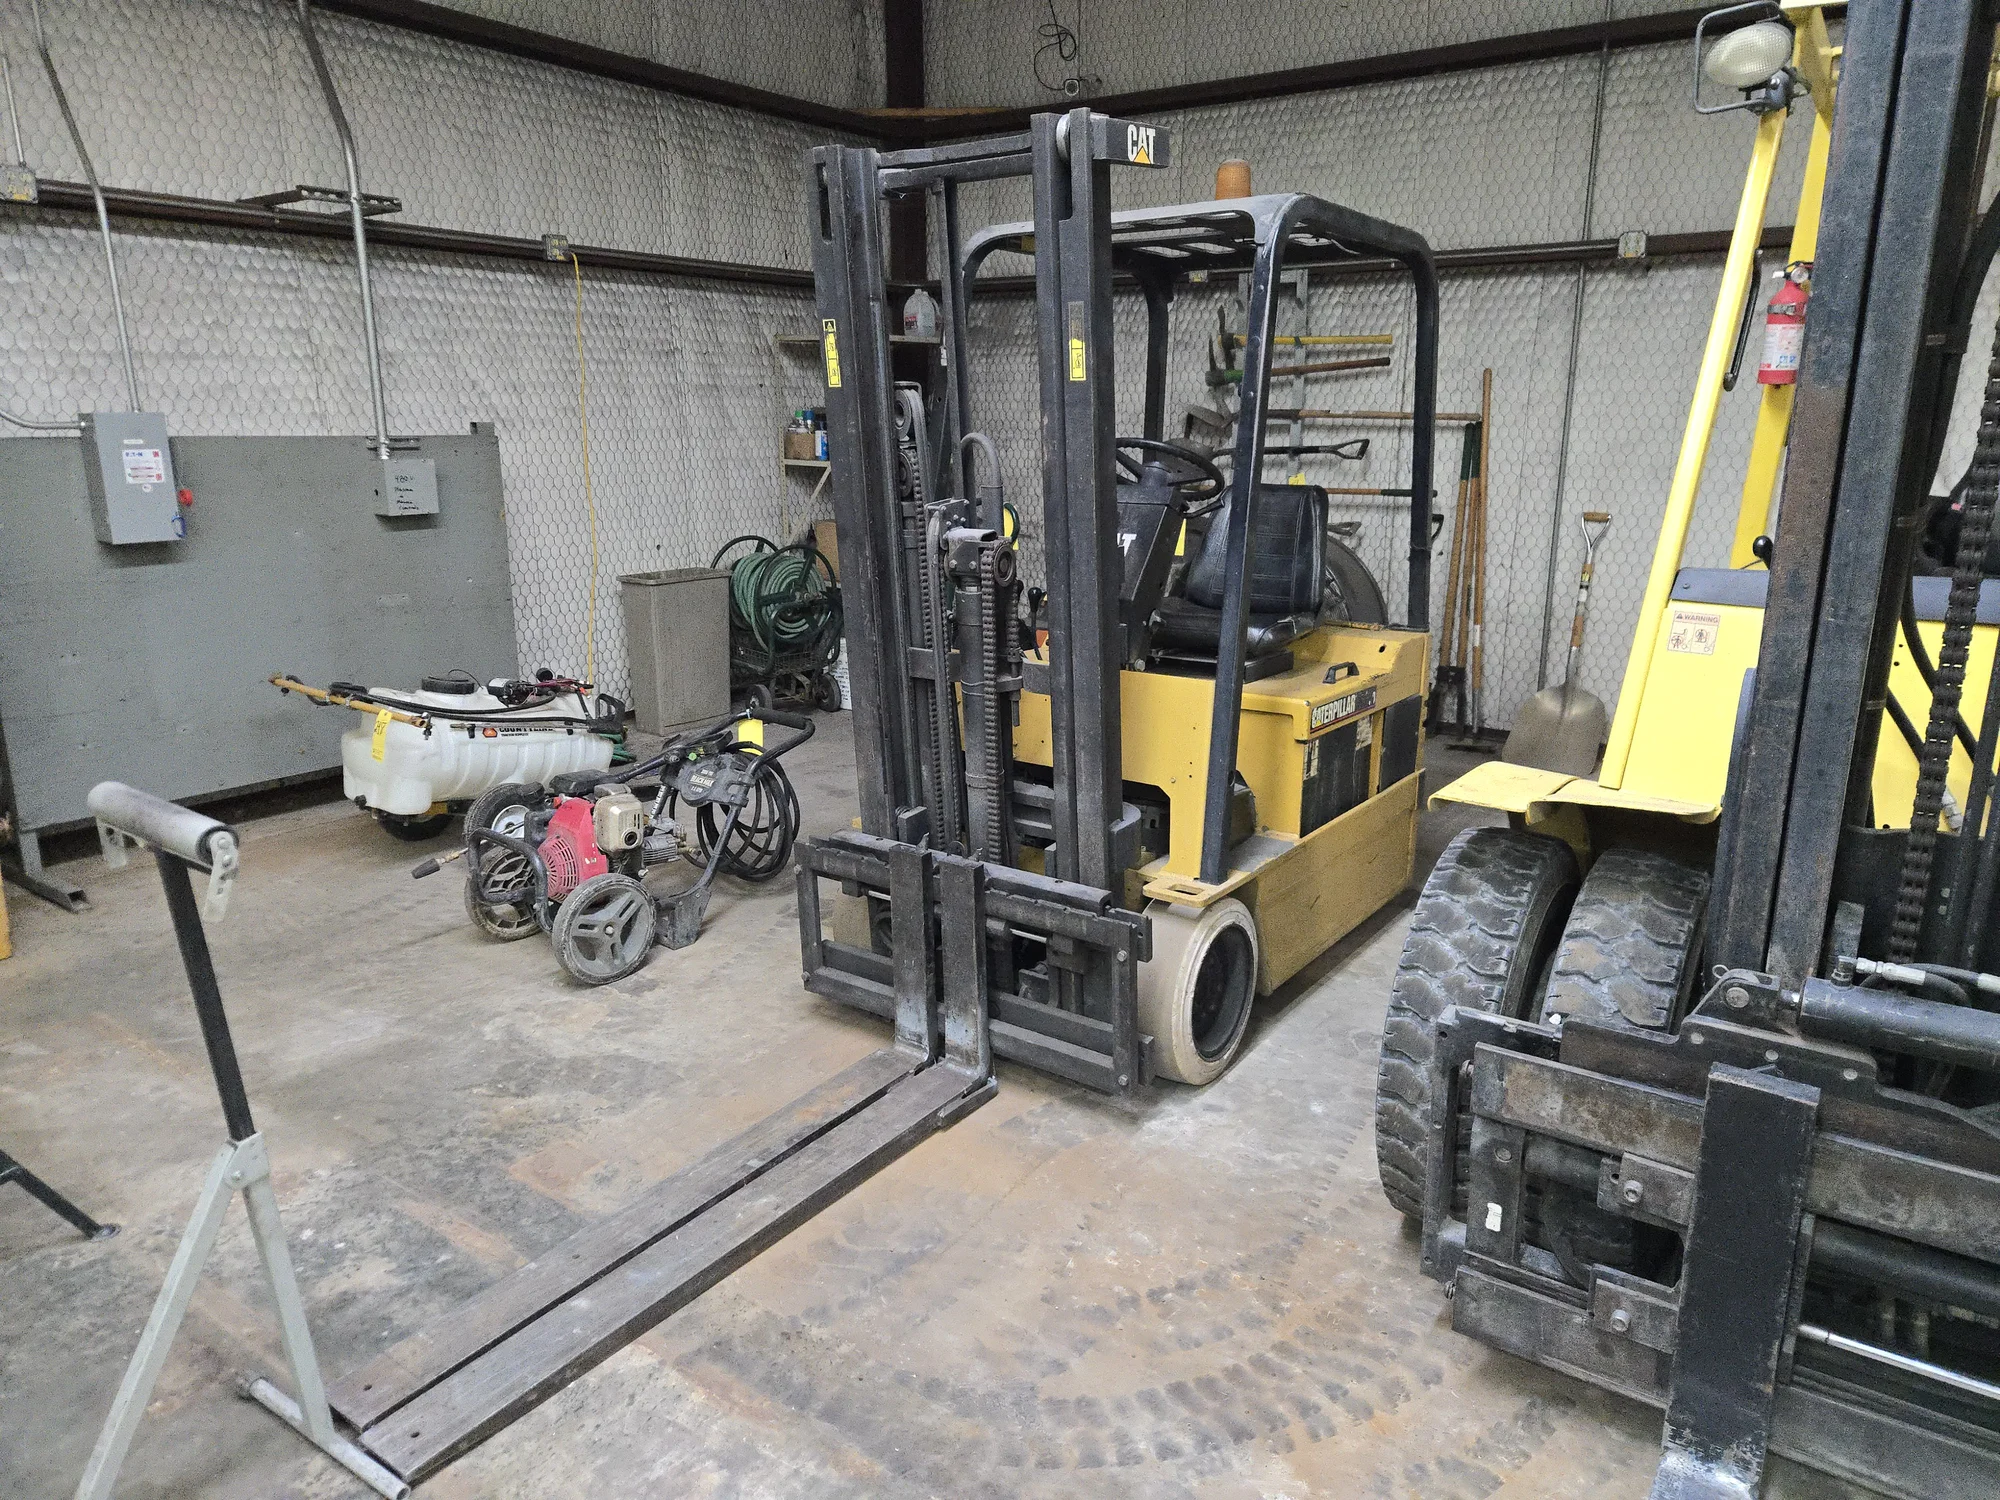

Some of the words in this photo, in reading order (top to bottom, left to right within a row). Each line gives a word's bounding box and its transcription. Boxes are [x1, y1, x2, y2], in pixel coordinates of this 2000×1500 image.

[1127, 124, 1156, 164] CAT
[1684, 613, 1718, 623] WARNING
[1311, 694, 1356, 729] CATERPILLAR
